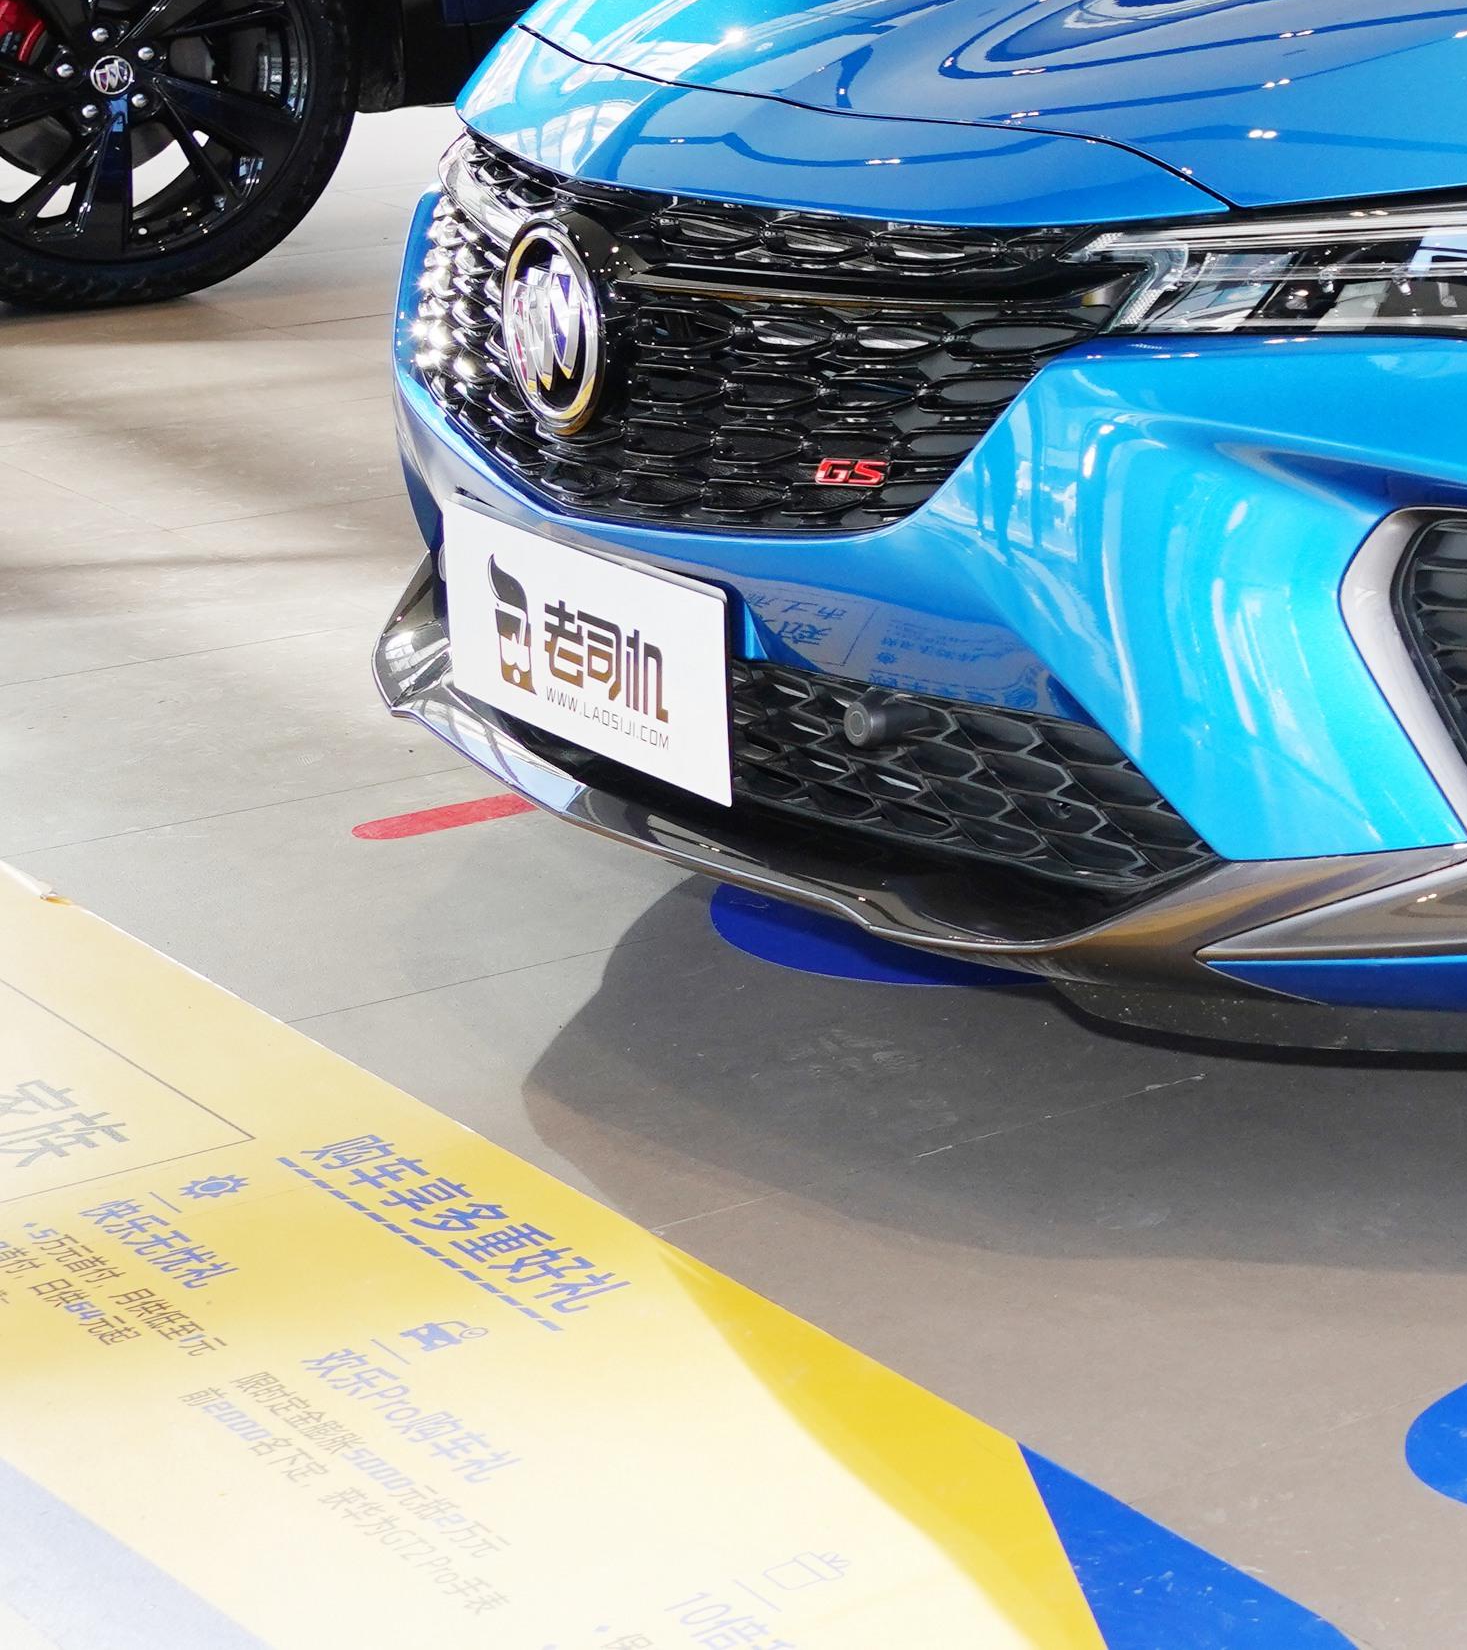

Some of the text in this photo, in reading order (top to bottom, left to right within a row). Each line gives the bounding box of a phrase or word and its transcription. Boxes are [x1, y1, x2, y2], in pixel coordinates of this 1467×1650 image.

[814, 457, 887, 488] GS
[544, 599, 669, 724] 老司机
[545, 686, 670, 751] WWW.LAOSIJI.COM
[78, 1198, 240, 1290] 快乐无忧礼
[300, 1134, 633, 1314] 购车享多重好礼
[301, 1347, 522, 1484] 欢乐Pro购车礼
